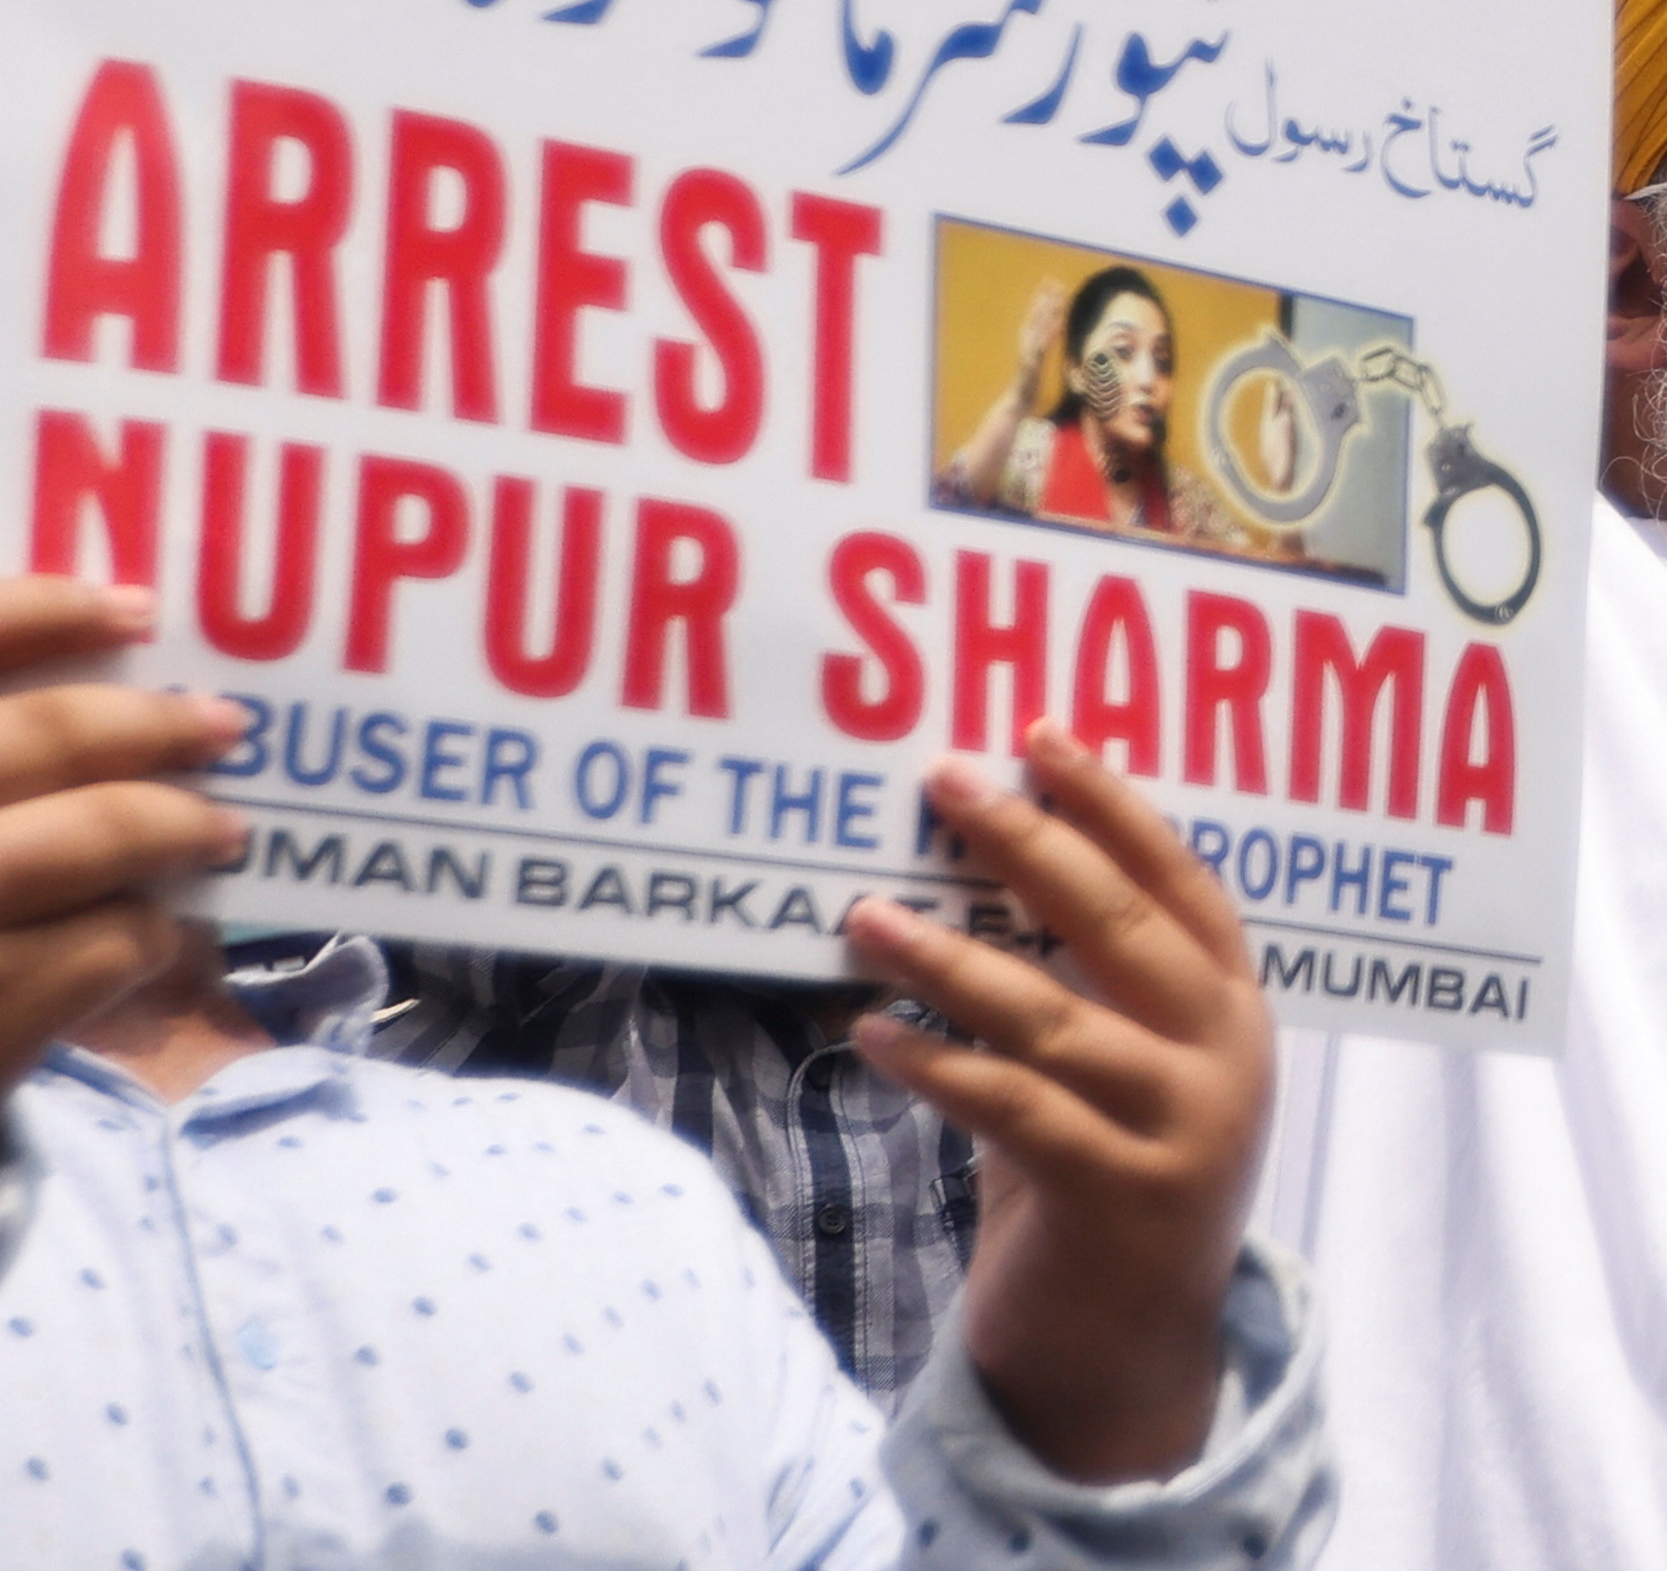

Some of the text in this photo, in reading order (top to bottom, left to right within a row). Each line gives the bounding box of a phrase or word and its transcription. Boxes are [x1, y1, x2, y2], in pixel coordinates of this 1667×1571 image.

[1226, 57, 1373, 173] رسول
[1380, 95, 1558, 209] گستاخ
[40, 56, 886, 485] ARREST
[29, 407, 1516, 837] NUPUR SHARMA
[200, 690, 539, 812] BUSER
[574, 739, 695, 826] OF
[719, 757, 885, 851] THE
[1168, 813, 1454, 927] ROPHET
[1260, 944, 1533, 1022] MUMBAI
